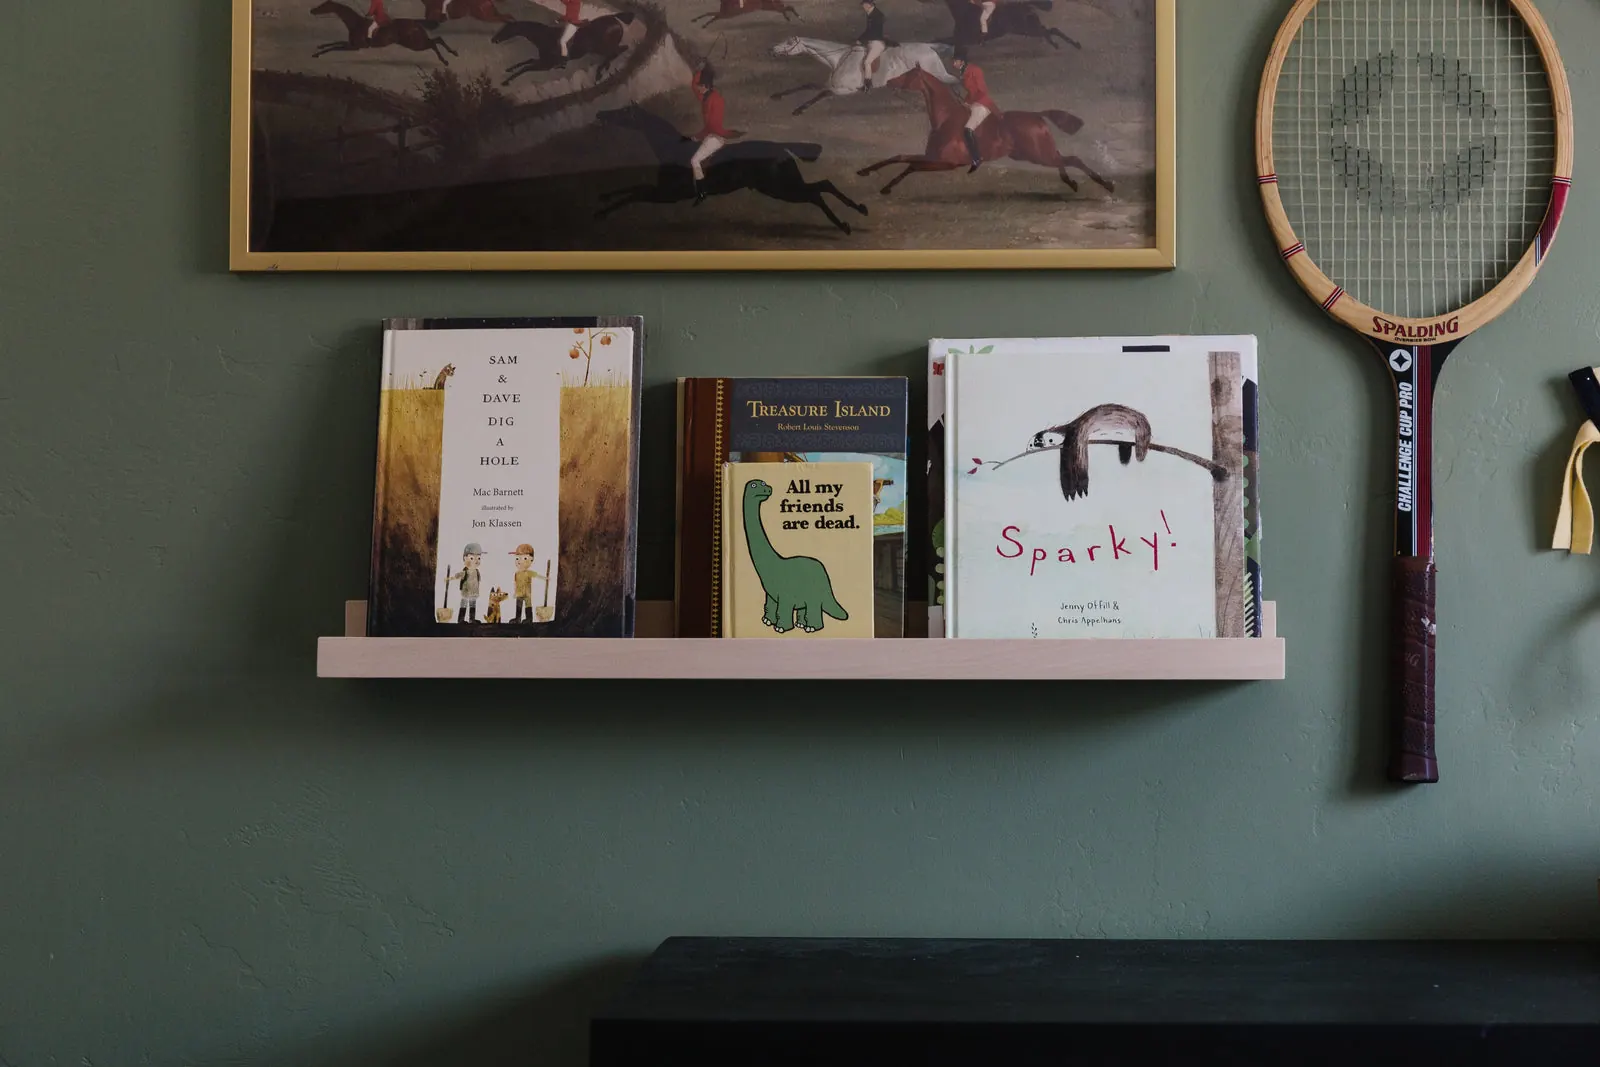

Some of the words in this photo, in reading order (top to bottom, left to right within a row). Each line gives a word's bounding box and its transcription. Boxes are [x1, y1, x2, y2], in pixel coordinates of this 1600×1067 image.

[1372, 315, 1459, 338] SPALDING
[489, 355, 519, 365] SAM
[497, 374, 508, 384] &
[483, 393, 521, 403] DAVE
[1399, 381, 1413, 409] PRO
[488, 416, 514, 427] DIG
[777, 422, 801, 431] Robert
[803, 422, 822, 431] Louis
[824, 423, 859, 431] Stevenson
[1400, 410, 1413, 436] CUP
[496, 437, 504, 447] A
[480, 456, 519, 466] HOLE
[1398, 439, 1412, 512] CHALLENGE
[473, 488, 491, 497] Mac
[493, 488, 524, 497] Barnett
[786, 479, 811, 494] All
[815, 483, 843, 497] my
[780, 499, 844, 513] friends
[472, 519, 486, 528] Jon
[489, 518, 522, 528] Klassen
[782, 519, 809, 530] are
[814, 515, 860, 530] dead.
[996, 509, 1176, 576] Sparky!
[1060, 602, 1084, 613] Jenny
[1112, 601, 1120, 610] &
[1057, 616, 1078, 624] Chris
[1081, 616, 1121, 627] Appelhans
